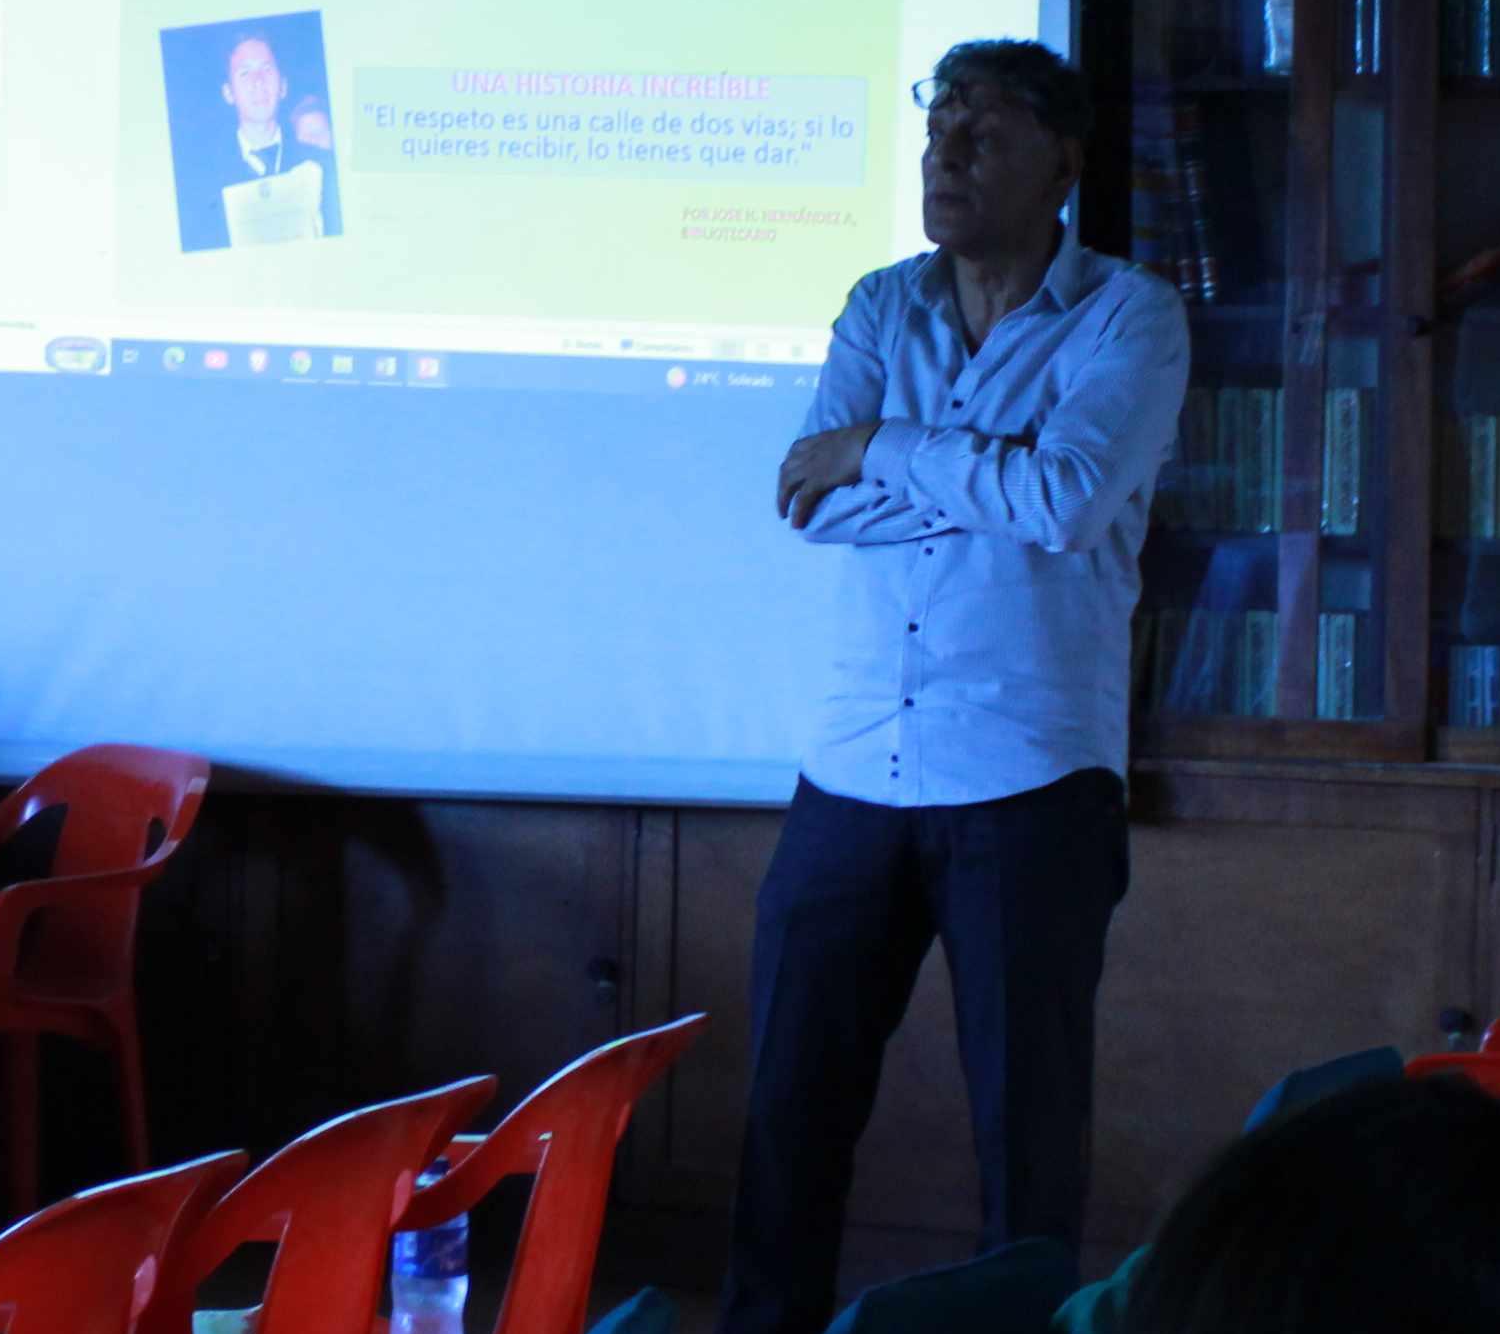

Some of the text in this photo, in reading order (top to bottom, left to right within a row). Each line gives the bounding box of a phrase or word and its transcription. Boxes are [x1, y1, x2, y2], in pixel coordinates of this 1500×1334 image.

[452, 69, 772, 101] UNA HISTORIA INCREÍBLE
[403, 109, 495, 133] respeto
[502, 114, 529, 131] es
[536, 115, 582, 132] una
[589, 111, 644, 134] calle
[652, 111, 684, 135] de
[690, 112, 735, 135] dos
[804, 114, 824, 138] si
[831, 115, 855, 138] lo
[401, 135, 490, 160] quieres
[498, 137, 579, 163] recibir,
[587, 138, 610, 160] lo
[617, 139, 692, 161] tienes
[699, 145, 746, 167] que
